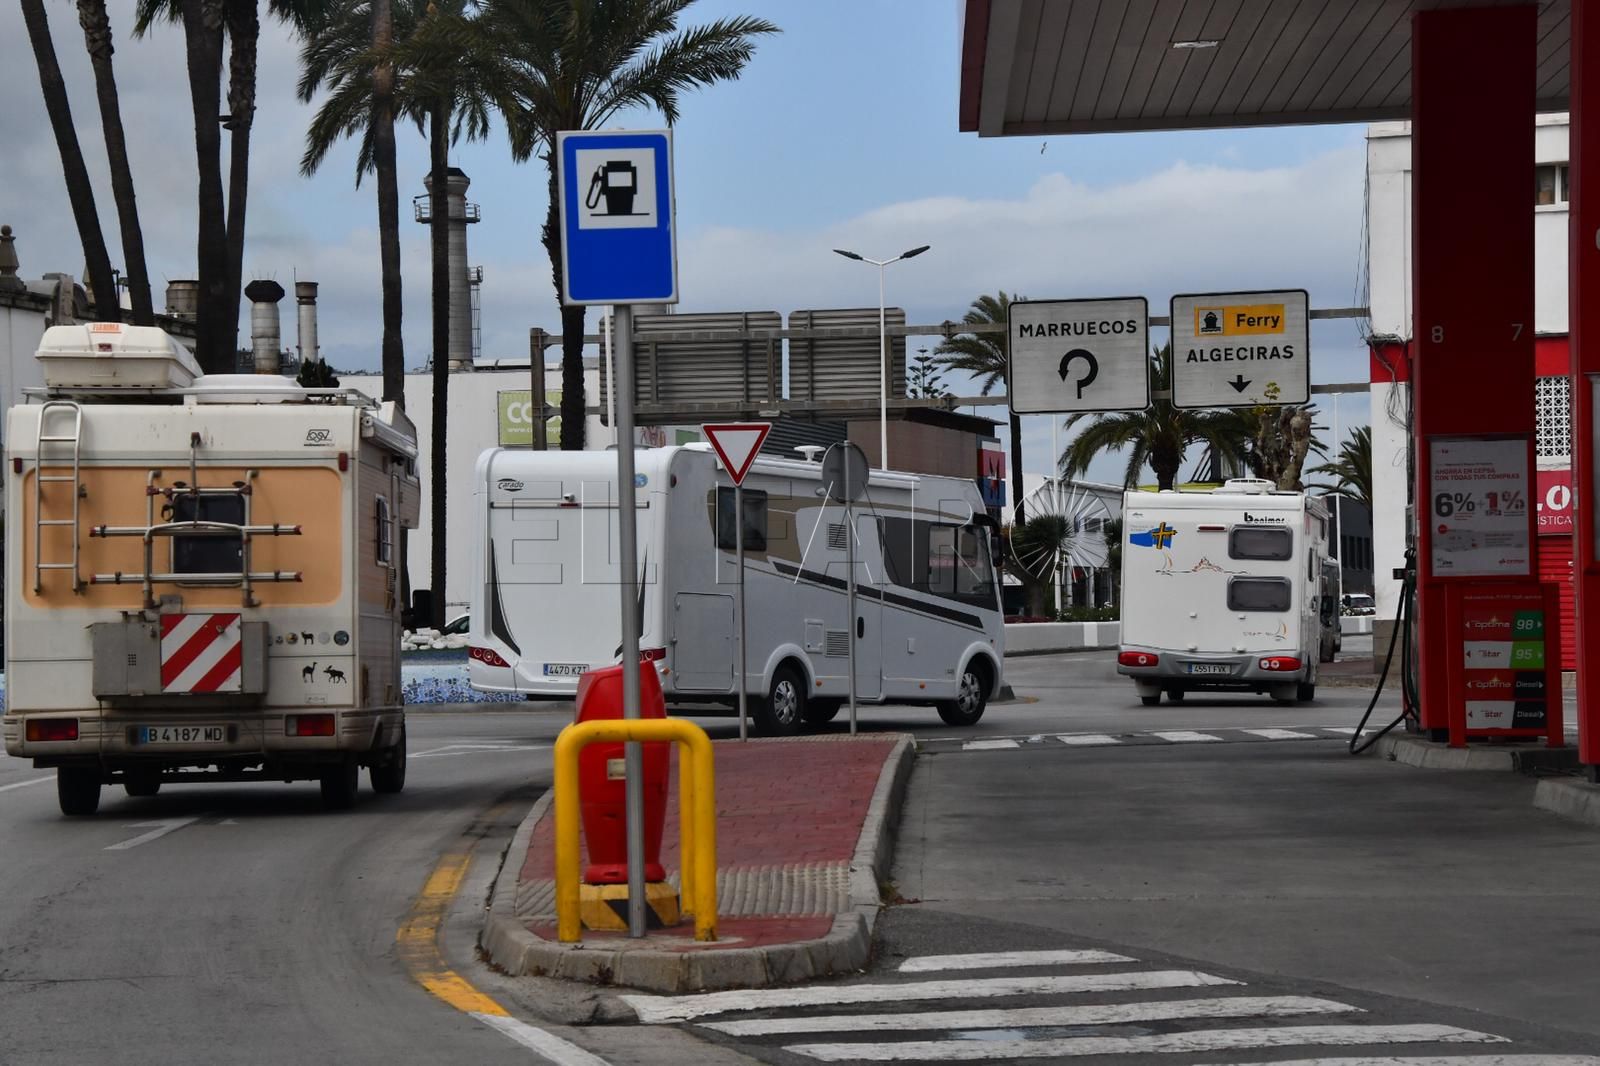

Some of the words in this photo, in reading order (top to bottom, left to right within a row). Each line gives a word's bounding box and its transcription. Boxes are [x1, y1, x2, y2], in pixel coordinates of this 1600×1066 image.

[1236, 313, 1280, 328] Ferry
[1019, 320, 1137, 338] MARRUECOS
[1431, 325, 1444, 343] 8
[1511, 323, 1524, 341] 7
[1187, 345, 1294, 363] ALGECIRAS
[1435, 492, 1475, 517] 6%
[1516, 619, 1534, 630] 98
[1516, 649, 1532, 660] 95
[1515, 680, 1539, 688] Diesel
[1517, 710, 1540, 718] Diesel
[148, 728, 158, 742] B
[162, 728, 200, 742] 4187
[204, 728, 222, 741] MD
